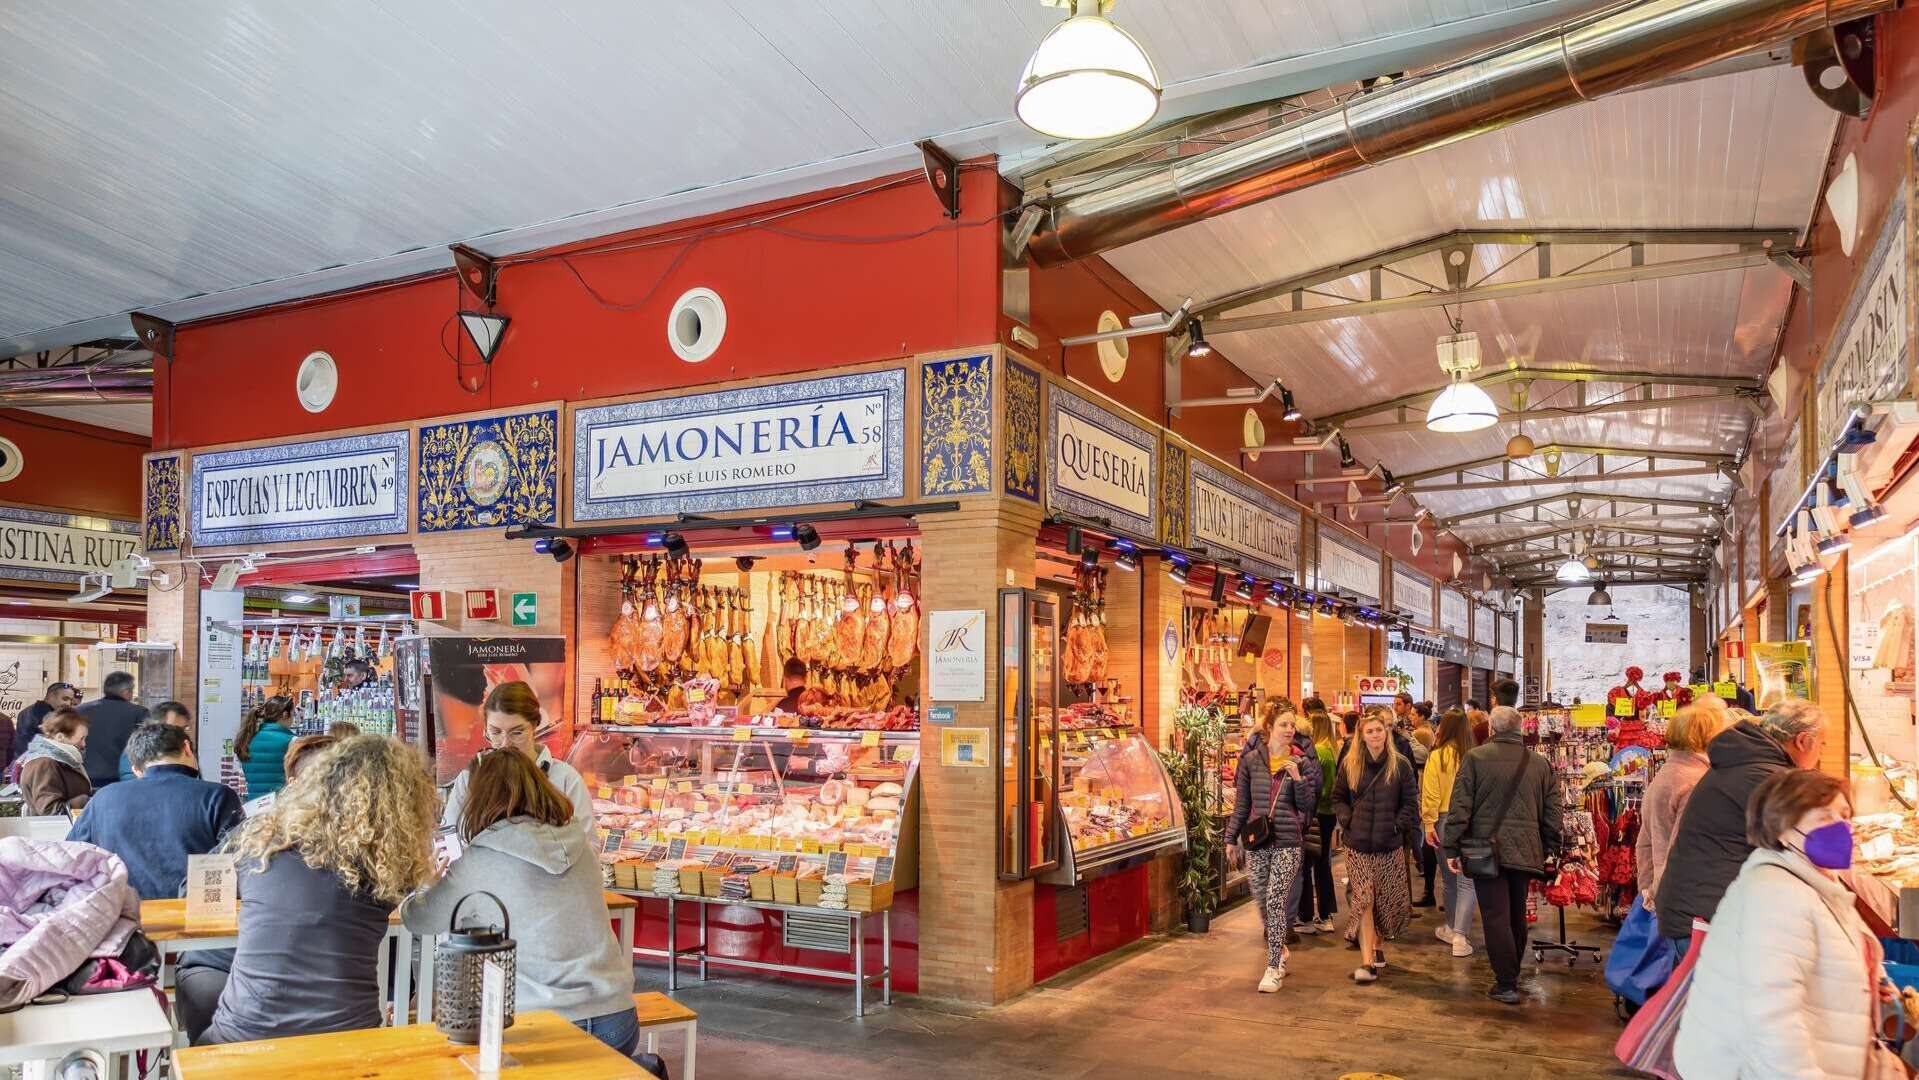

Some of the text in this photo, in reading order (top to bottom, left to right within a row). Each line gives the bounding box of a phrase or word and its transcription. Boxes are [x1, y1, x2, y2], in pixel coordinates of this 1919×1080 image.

[593, 404, 860, 479] JAMONERÍA
[861, 425, 882, 444] 58
[381, 477, 394, 490] 49
[664, 463, 796, 487] JOSÉ LUIS ROMERO
[1060, 433, 1147, 497] QUESERÍA
[206, 463, 377, 518] ESPECIAS Y LEGUMBRES
[1197, 486, 1227, 538] VINOS
[1229, 500, 1236, 542] Y
[468, 643, 527, 656] JAMONERÍA
